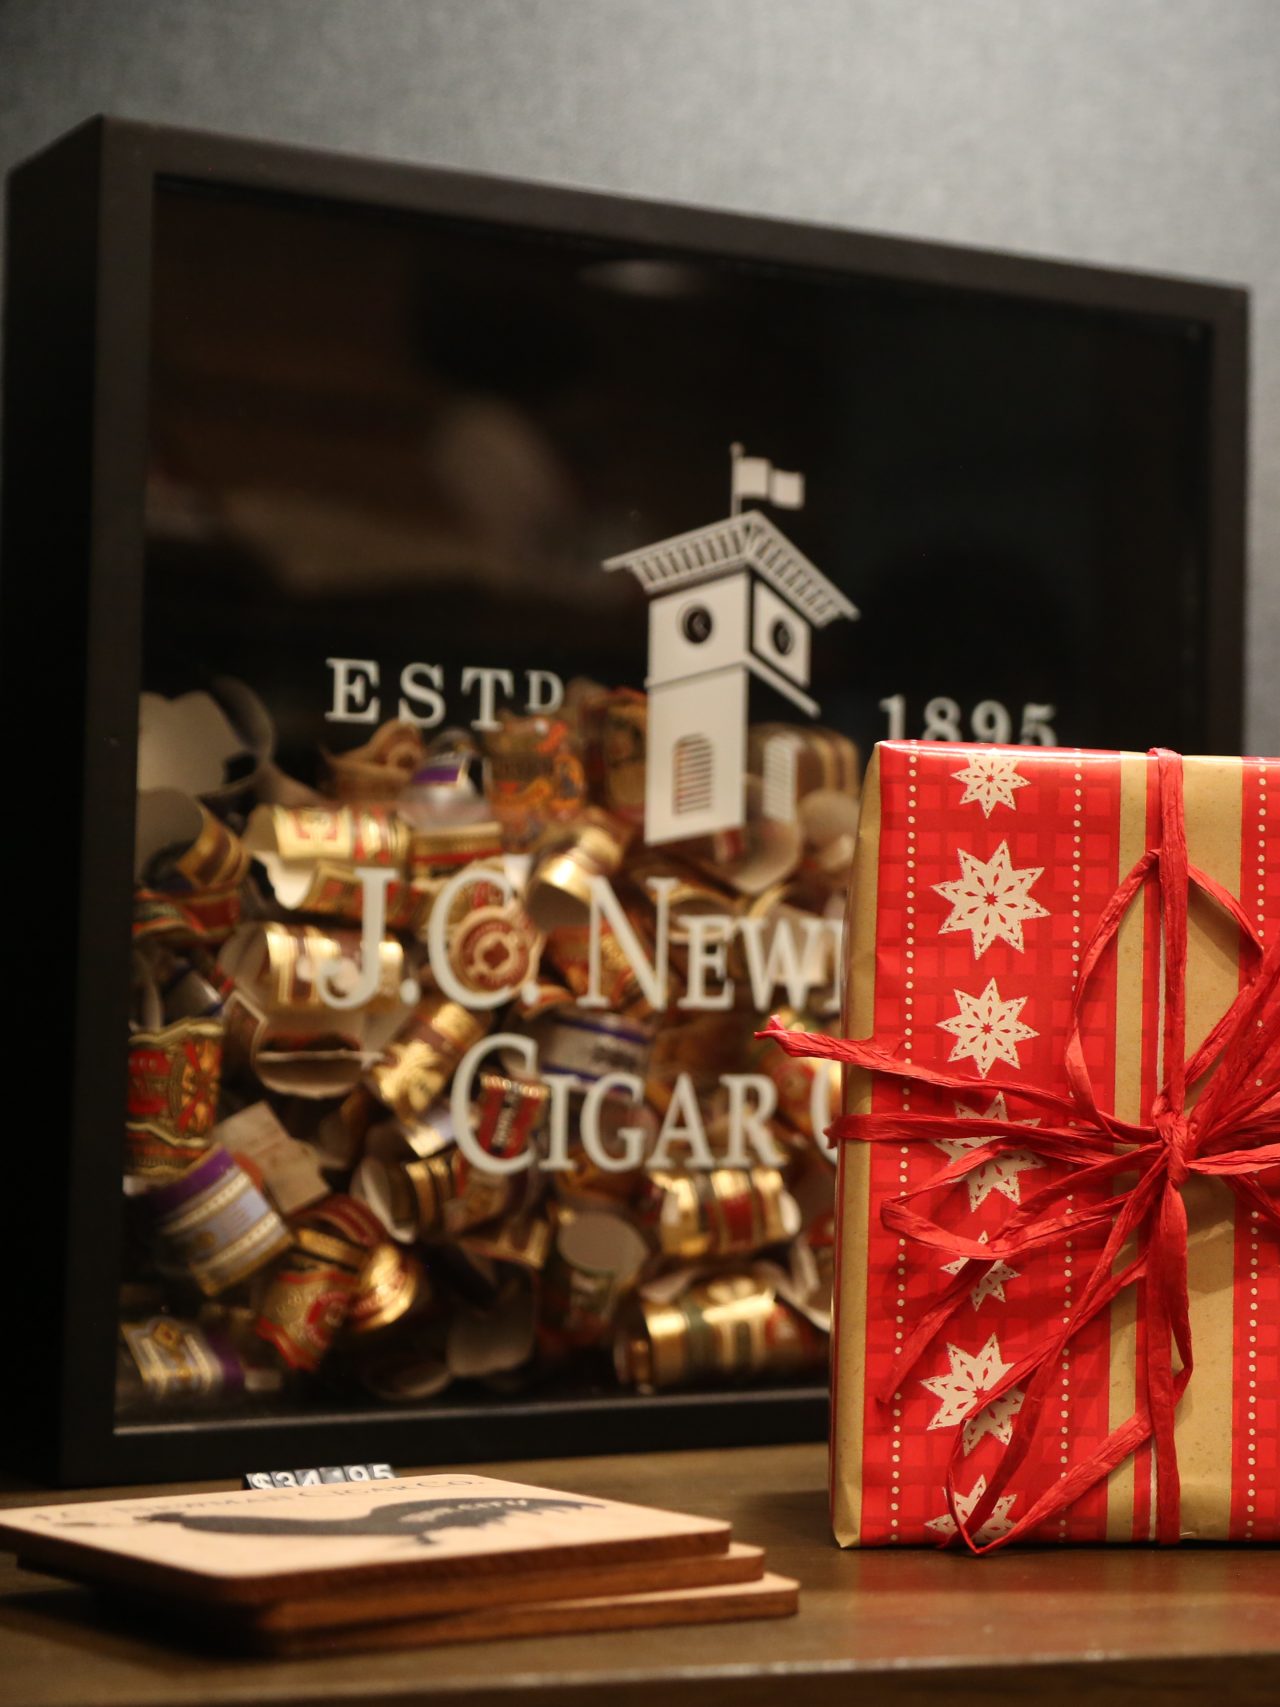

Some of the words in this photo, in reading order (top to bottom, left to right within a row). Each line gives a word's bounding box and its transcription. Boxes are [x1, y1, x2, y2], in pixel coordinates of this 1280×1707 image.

[324, 657, 565, 732] ESTD
[878, 694, 1059, 747] 1895
[576, 874, 842, 1013] NEW
[450, 1033, 787, 1174] CIGAR
[251, 1463, 396, 1489] $3495
